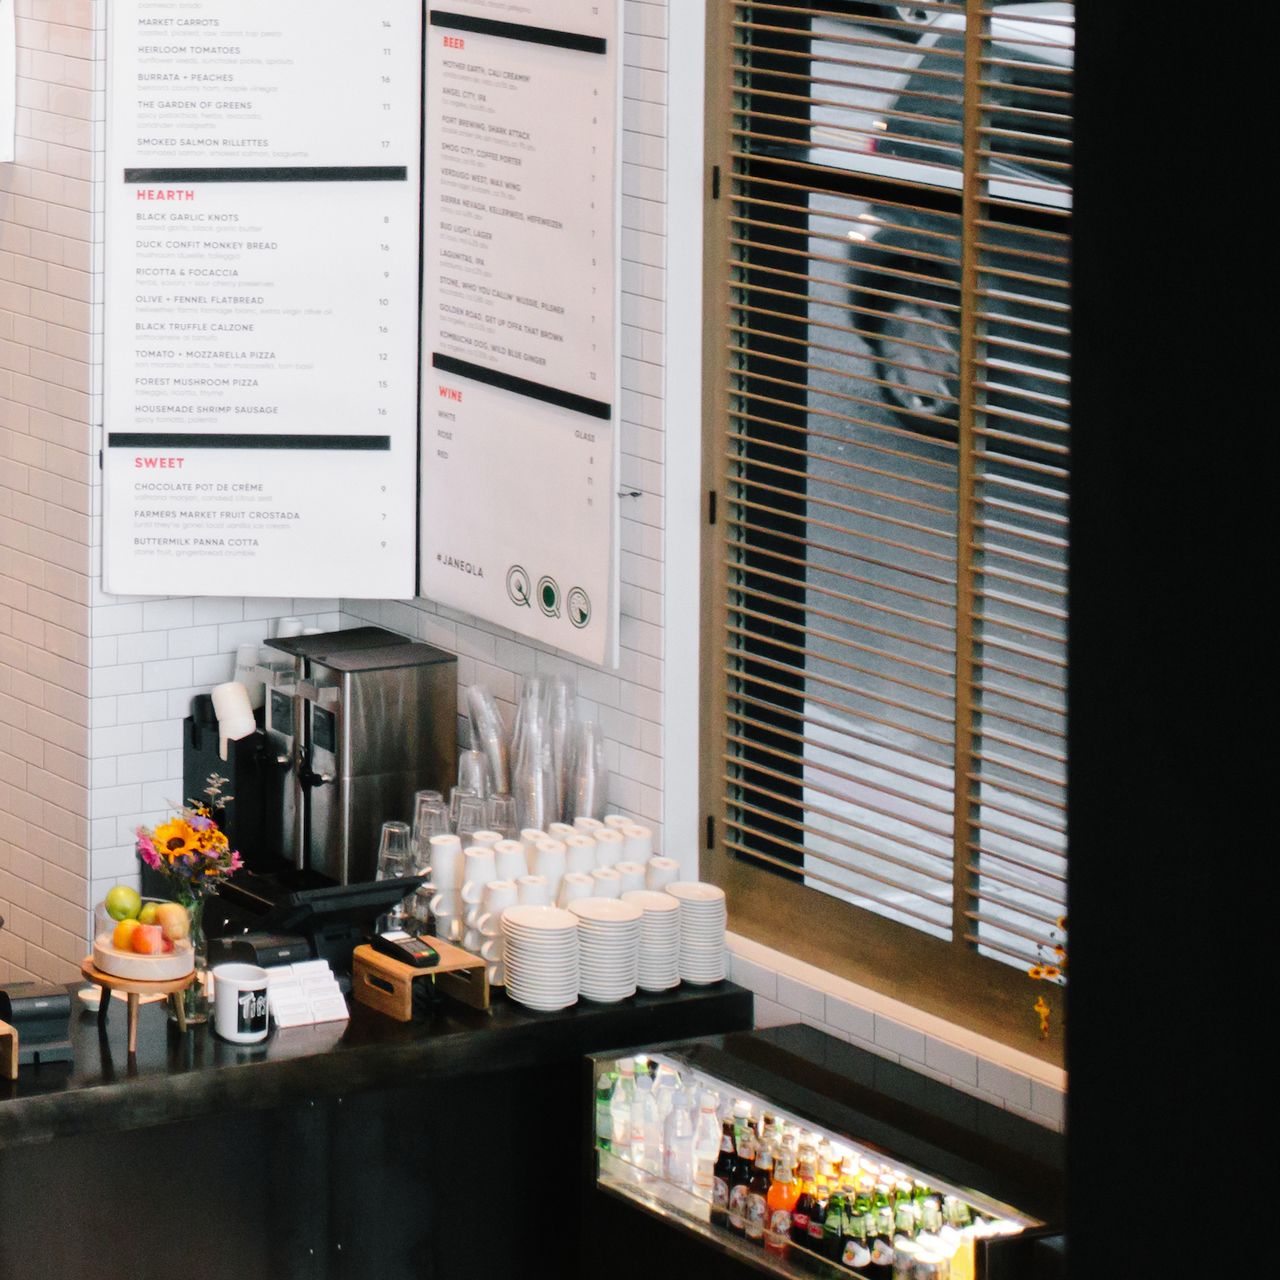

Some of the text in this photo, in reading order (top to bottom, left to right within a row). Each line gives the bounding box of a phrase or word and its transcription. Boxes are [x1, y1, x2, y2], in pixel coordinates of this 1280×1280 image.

[138, 18, 174, 26] MARKET
[176, 19, 219, 27] CARROTS
[443, 36, 465, 50] BEER
[138, 46, 187, 54] HEIRLOOM
[190, 46, 241, 55] TOMATOES
[138, 73, 180, 81] BURRATA
[191, 74, 234, 82] PEACHES
[138, 101, 154, 109] THE
[157, 101, 197, 109] GARDEN
[199, 101, 212, 109] OF
[215, 101, 252, 110] GREENS
[137, 138, 177, 146] SMOKED
[180, 138, 219, 146] SALMON
[222, 139, 269, 147] RILLETTES
[137, 190, 194, 201] HEARTH
[136, 213, 166, 221] BLACK
[170, 213, 204, 222] GARLIC
[208, 214, 239, 222] KNOTS
[136, 240, 162, 248] DUCK
[166, 241, 200, 249] CONFIT
[203, 242, 243, 250] MONKEY
[246, 242, 278, 250] BREAD
[136, 268, 176, 276] RICOTTA
[179, 268, 186, 276] &
[188, 268, 239, 277] FOCACCIA
[136, 295, 162, 303] OLIVE
[174, 296, 207, 304] FENNEL
[211, 296, 264, 305] FLATBREAD
[135, 323, 166, 331] BLACK
[169, 323, 207, 331] TRUFFLE
[210, 323, 254, 332] CALZONE
[135, 350, 175, 358] TOMATO
[186, 350, 247, 359] MOZZARELLA
[250, 351, 276, 360] PIZZA
[135, 378, 170, 386] FOREST
[173, 378, 230, 386] MUSHROOM
[232, 379, 259, 387] PIZZA
[439, 386, 462, 403] WINE
[135, 405, 194, 413] HOUSEMADE
[196, 406, 232, 414] SHRIMP
[235, 406, 278, 414] SAUSAGE
[135, 457, 184, 469] SWEET
[134, 483, 192, 491] CHOCOLATE
[195, 483, 214, 491] POT
[217, 483, 228, 492] DE
[231, 483, 263, 492] CRÈME
[134, 510, 177, 519] FARMERS
[180, 511, 217, 519] MARKET
[220, 511, 246, 519] FRUIT
[249, 511, 300, 520] CROSTADA
[134, 537, 190, 546] BUTTERMILK
[193, 538, 225, 546] PANNA
[228, 538, 259, 547] COTTA
